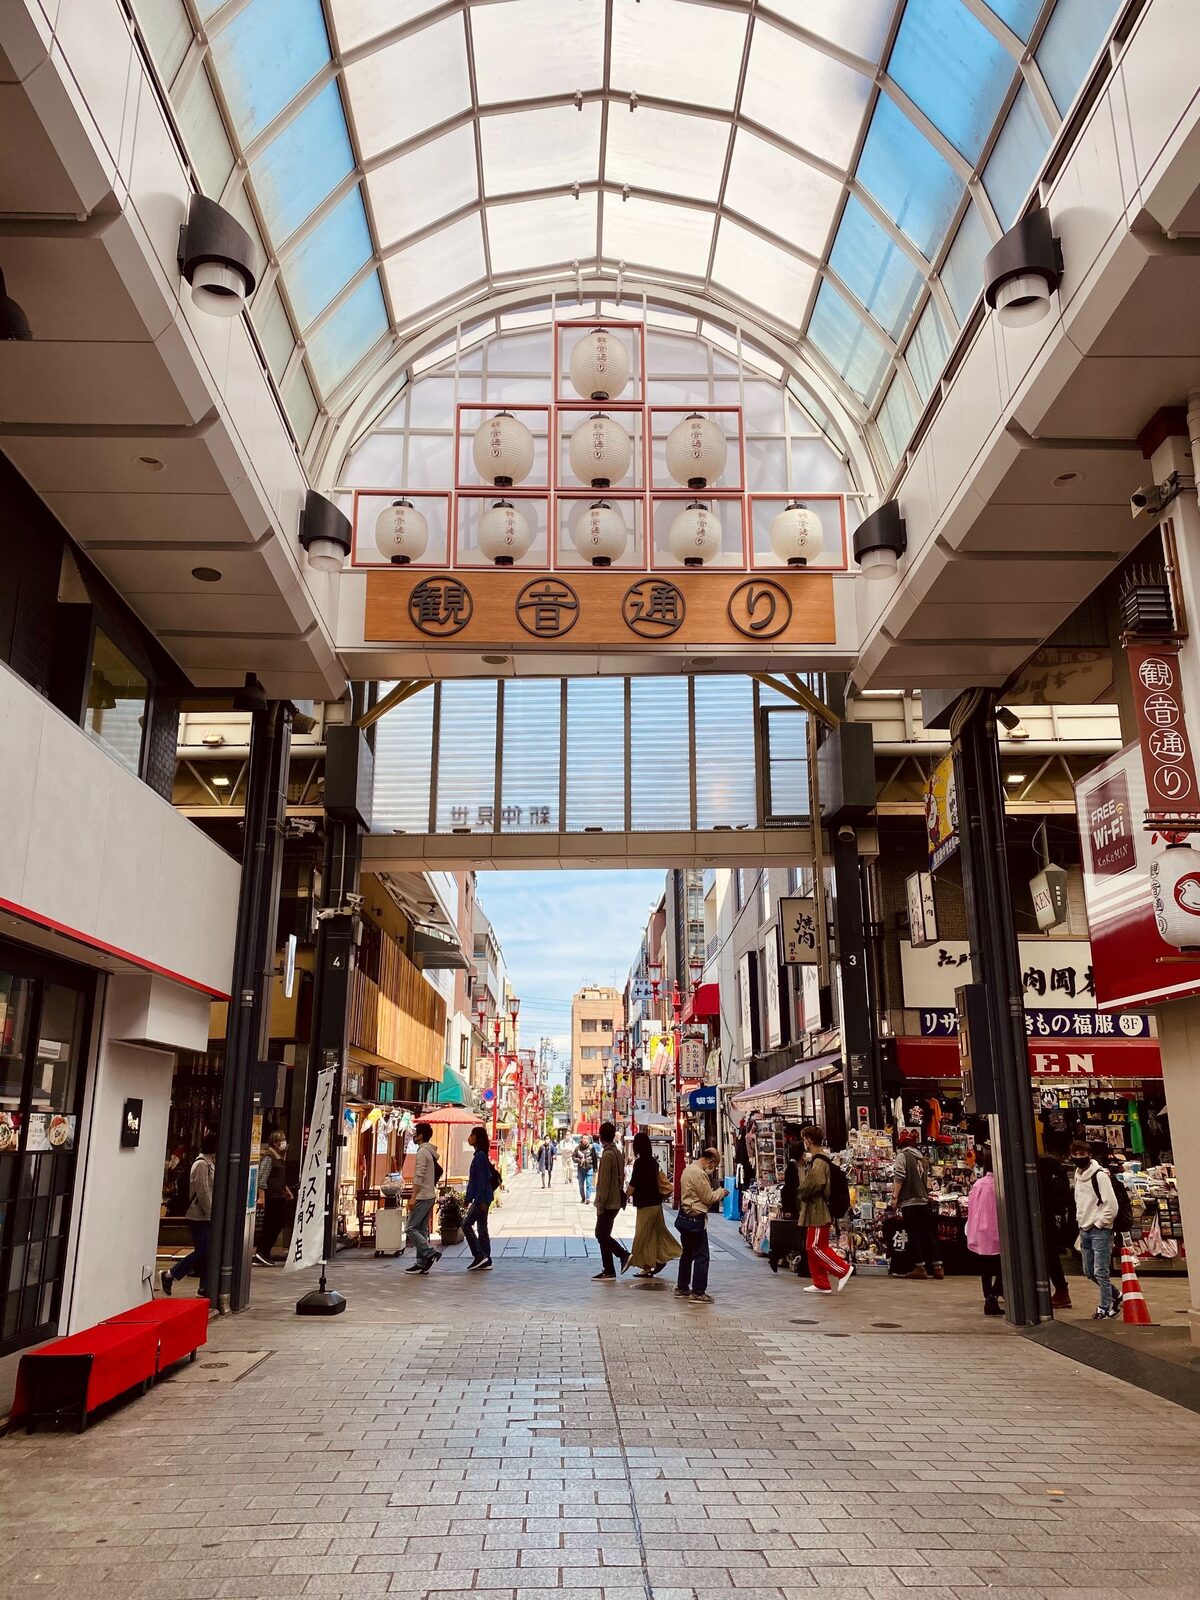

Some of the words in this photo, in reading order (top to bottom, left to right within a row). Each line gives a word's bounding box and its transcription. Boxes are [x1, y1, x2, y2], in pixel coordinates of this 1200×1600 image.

[409, 577, 791, 636] 観音通り
[1140, 660, 1190, 798] 観音通り
[1091, 799, 1116, 826] FREE
[1093, 815, 1125, 850] Wi-Fi
[1033, 889, 1051, 913] KEN
[793, 912, 816, 950] 焼肉
[333, 956, 340, 967] 4
[849, 955, 857, 966] 3
[937, 949, 977, 968] 江戸
[1122, 1017, 1139, 1030] 3F
[1031, 1053, 1096, 1073] EN
